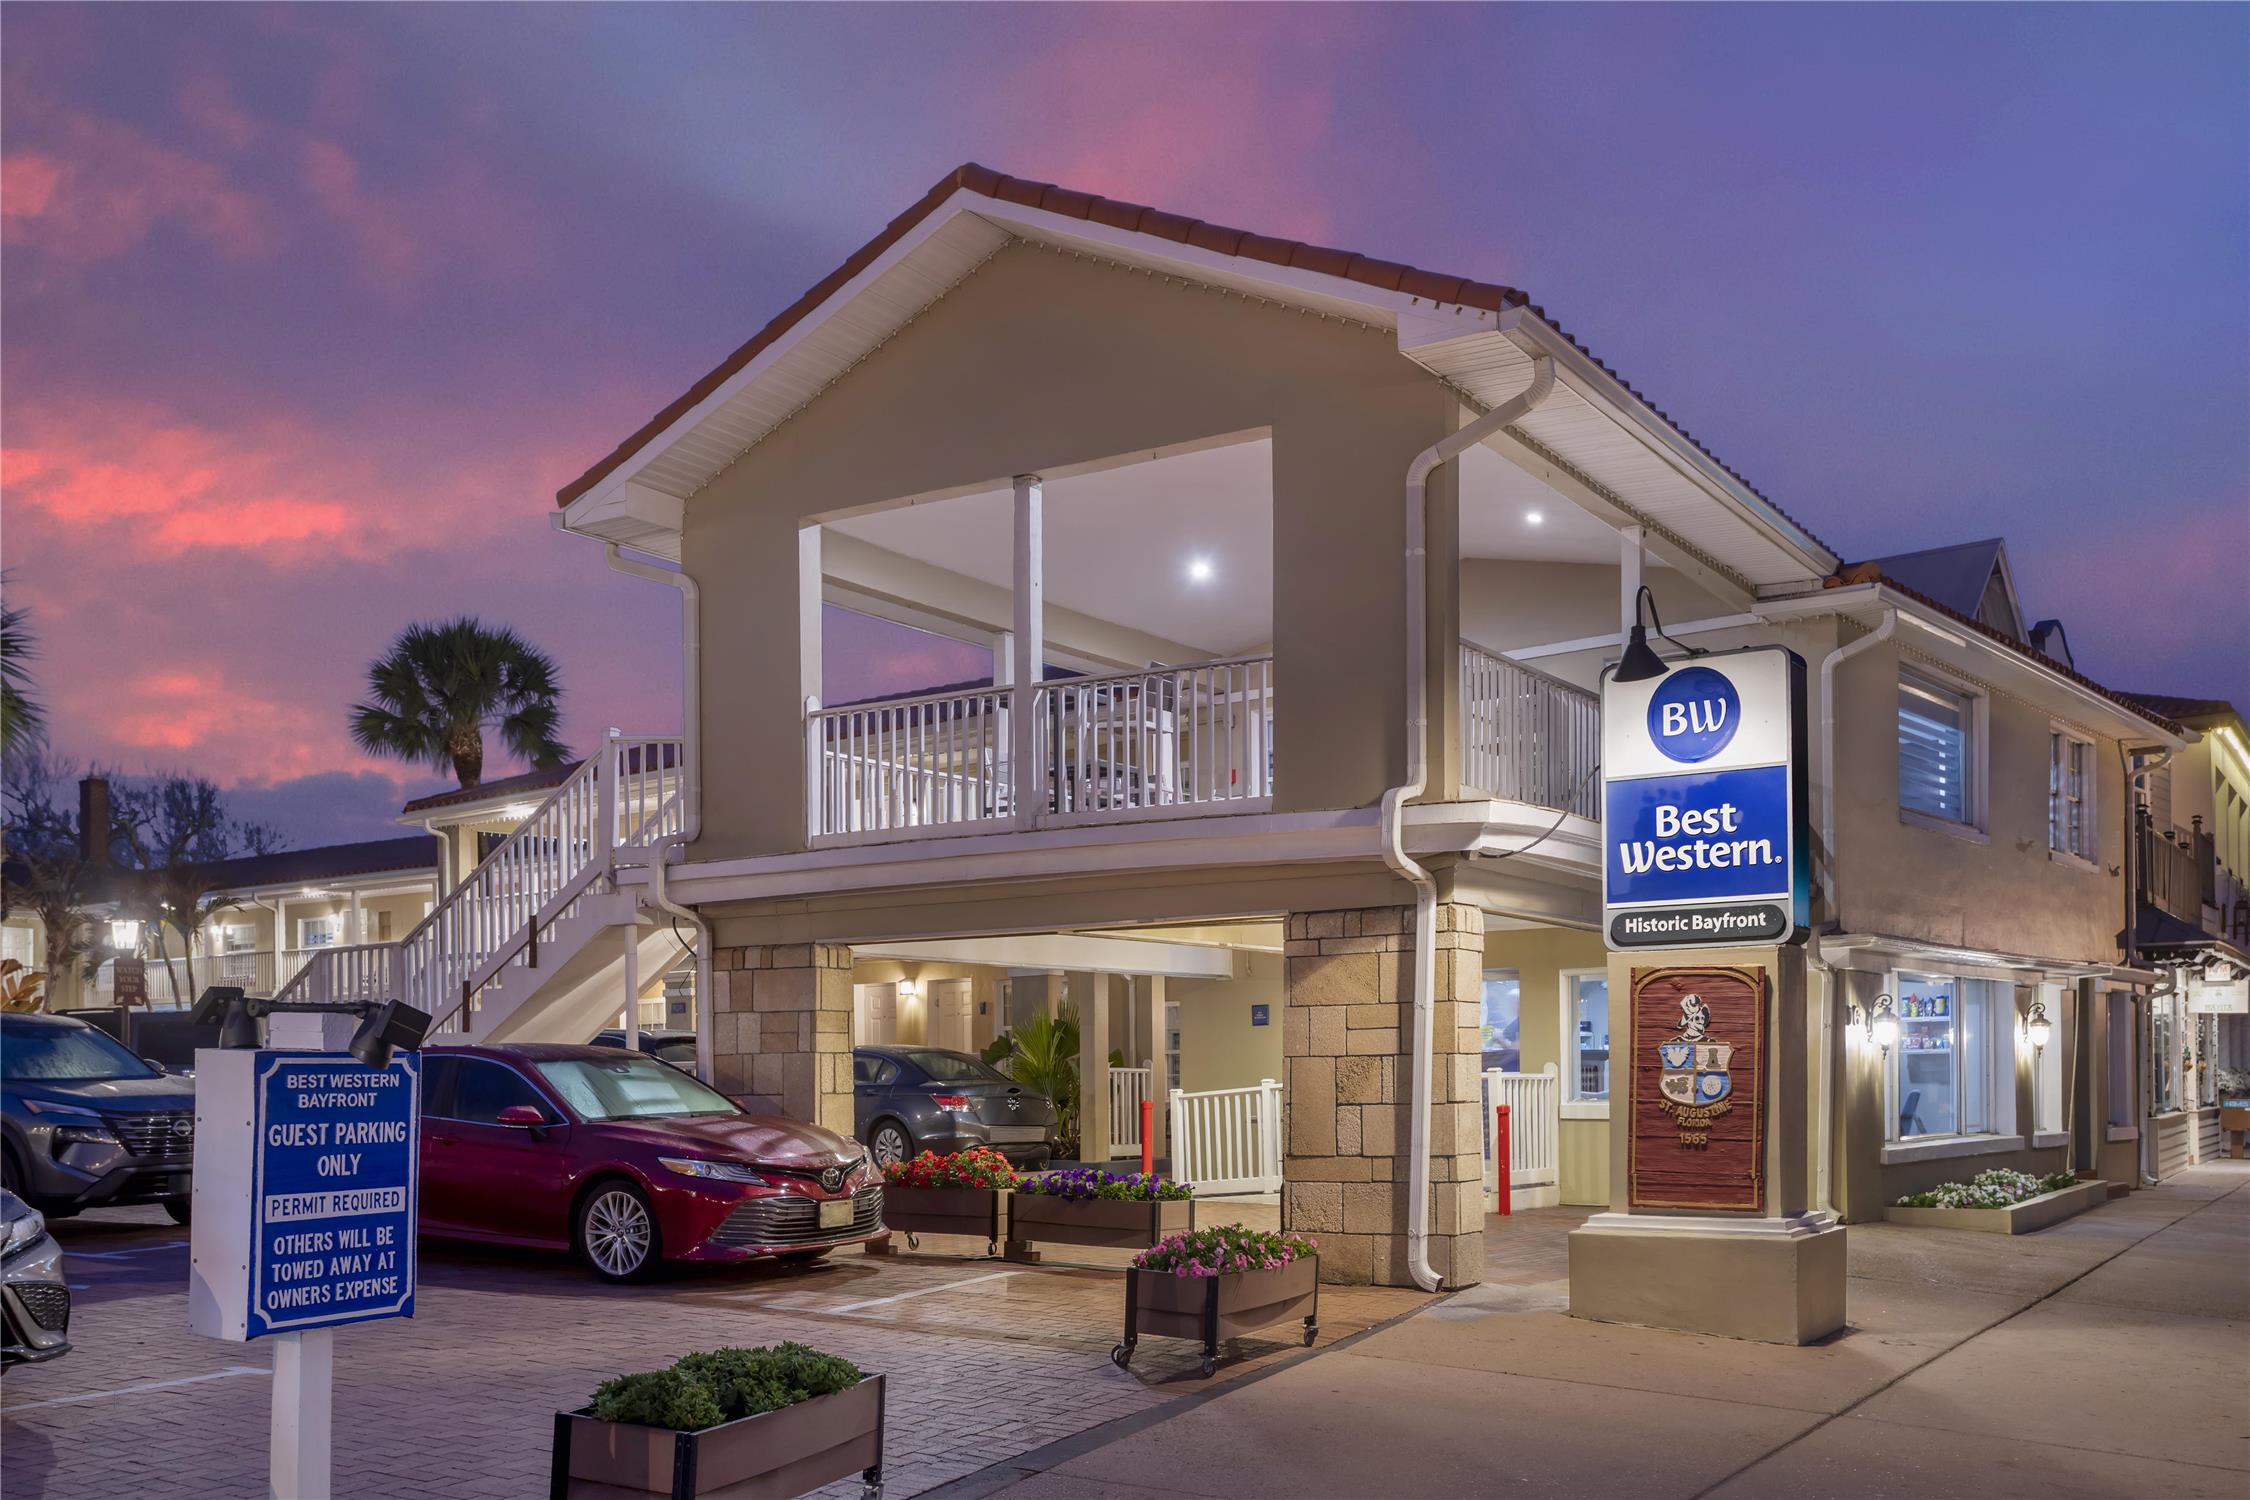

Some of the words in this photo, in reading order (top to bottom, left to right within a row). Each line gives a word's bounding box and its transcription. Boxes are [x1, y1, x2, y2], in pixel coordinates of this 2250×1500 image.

[1662, 697, 1727, 737] BW
[1655, 803, 1738, 838] Best
[1625, 915, 1689, 934] Historic
[1692, 912, 1767, 934] Bayfront
[287, 1074, 327, 1089] BEST
[330, 1073, 400, 1088] WESTERN
[298, 1092, 377, 1108] BAYFRONT
[1675, 1099, 1731, 1118] AUGUSTINE
[268, 1123, 329, 1147] GUEST
[335, 1121, 407, 1145] PARKING
[1679, 1132, 1708, 1144] 1565
[317, 1153, 362, 1176] ONLY
[271, 1195, 325, 1217] PERMIT
[332, 1190, 400, 1213] REQUIRED
[273, 1231, 333, 1256] OTHERS
[338, 1228, 371, 1249] WILL
[376, 1226, 394, 1246] BE
[271, 1258, 324, 1282] TOWED
[329, 1254, 372, 1277] AWAY
[377, 1251, 396, 1271] AT
[267, 1285, 331, 1310] OWNERS
[335, 1276, 398, 1301] EXPENSE
